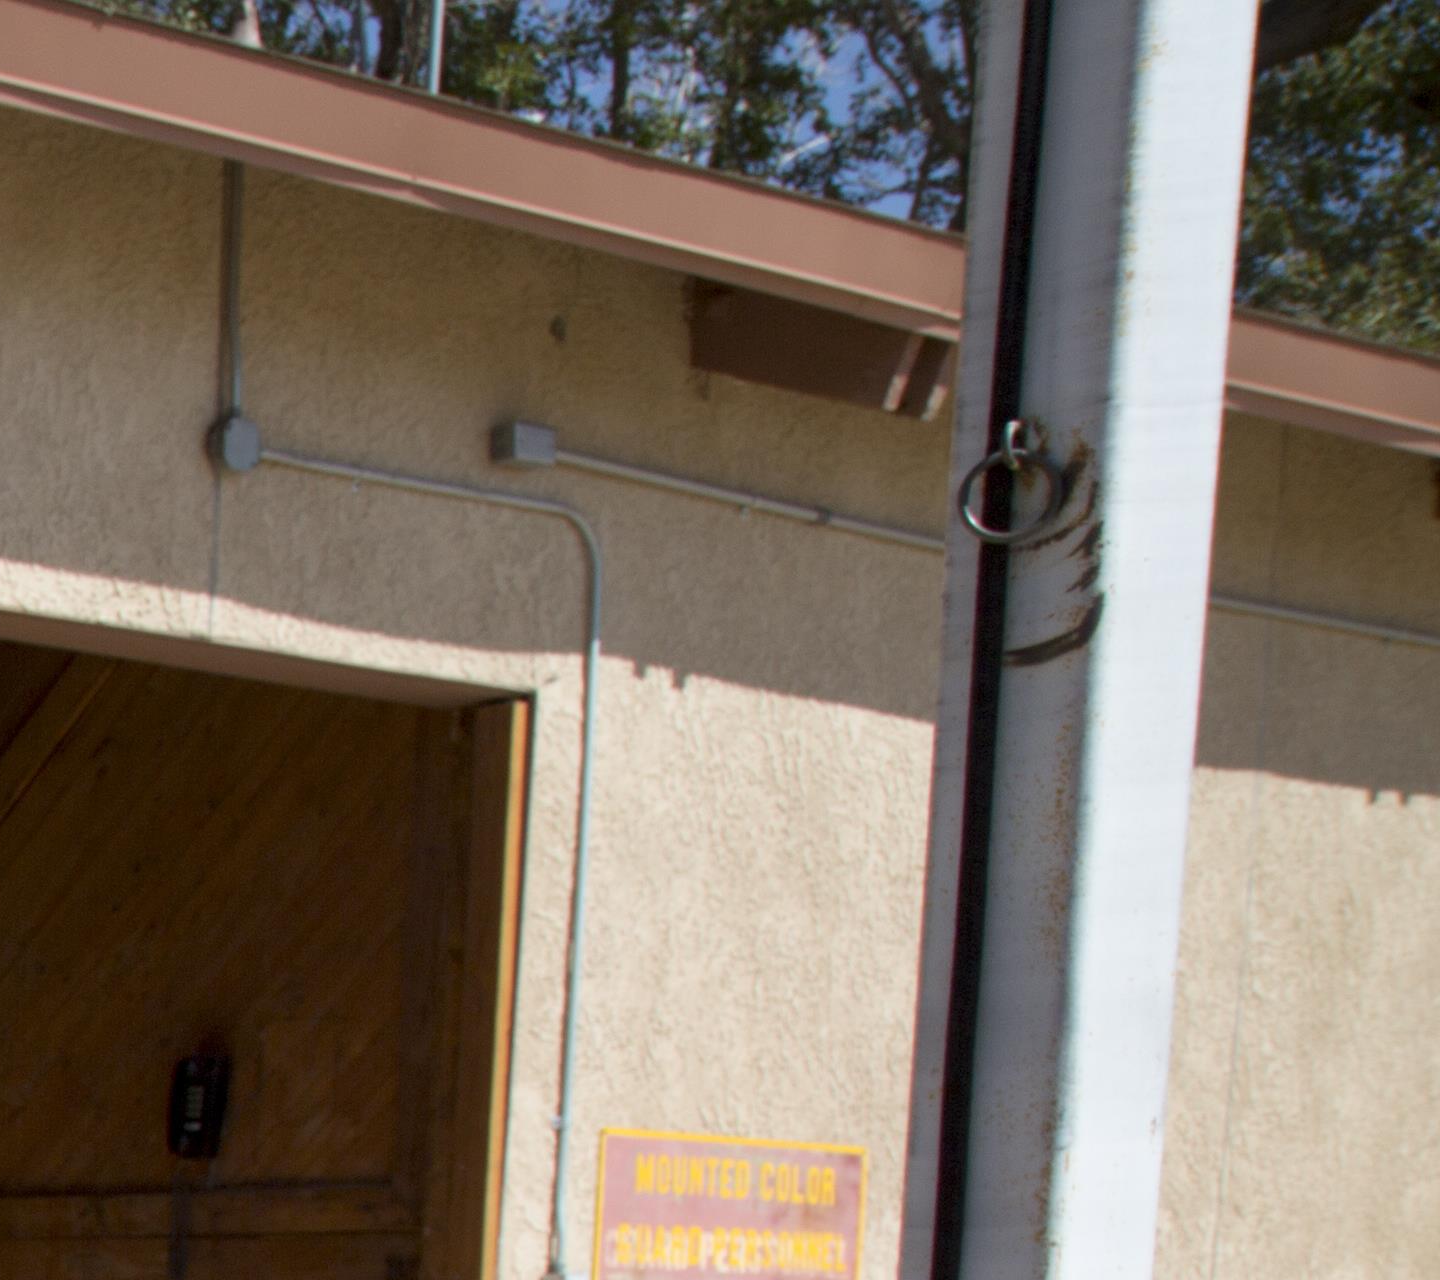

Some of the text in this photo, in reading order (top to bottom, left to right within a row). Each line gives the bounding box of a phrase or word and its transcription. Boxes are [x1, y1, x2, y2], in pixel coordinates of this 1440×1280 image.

[635, 1154, 834, 1204] MOUNTED COLOR
[616, 1223, 845, 1271] GUARD PERSONNEL
